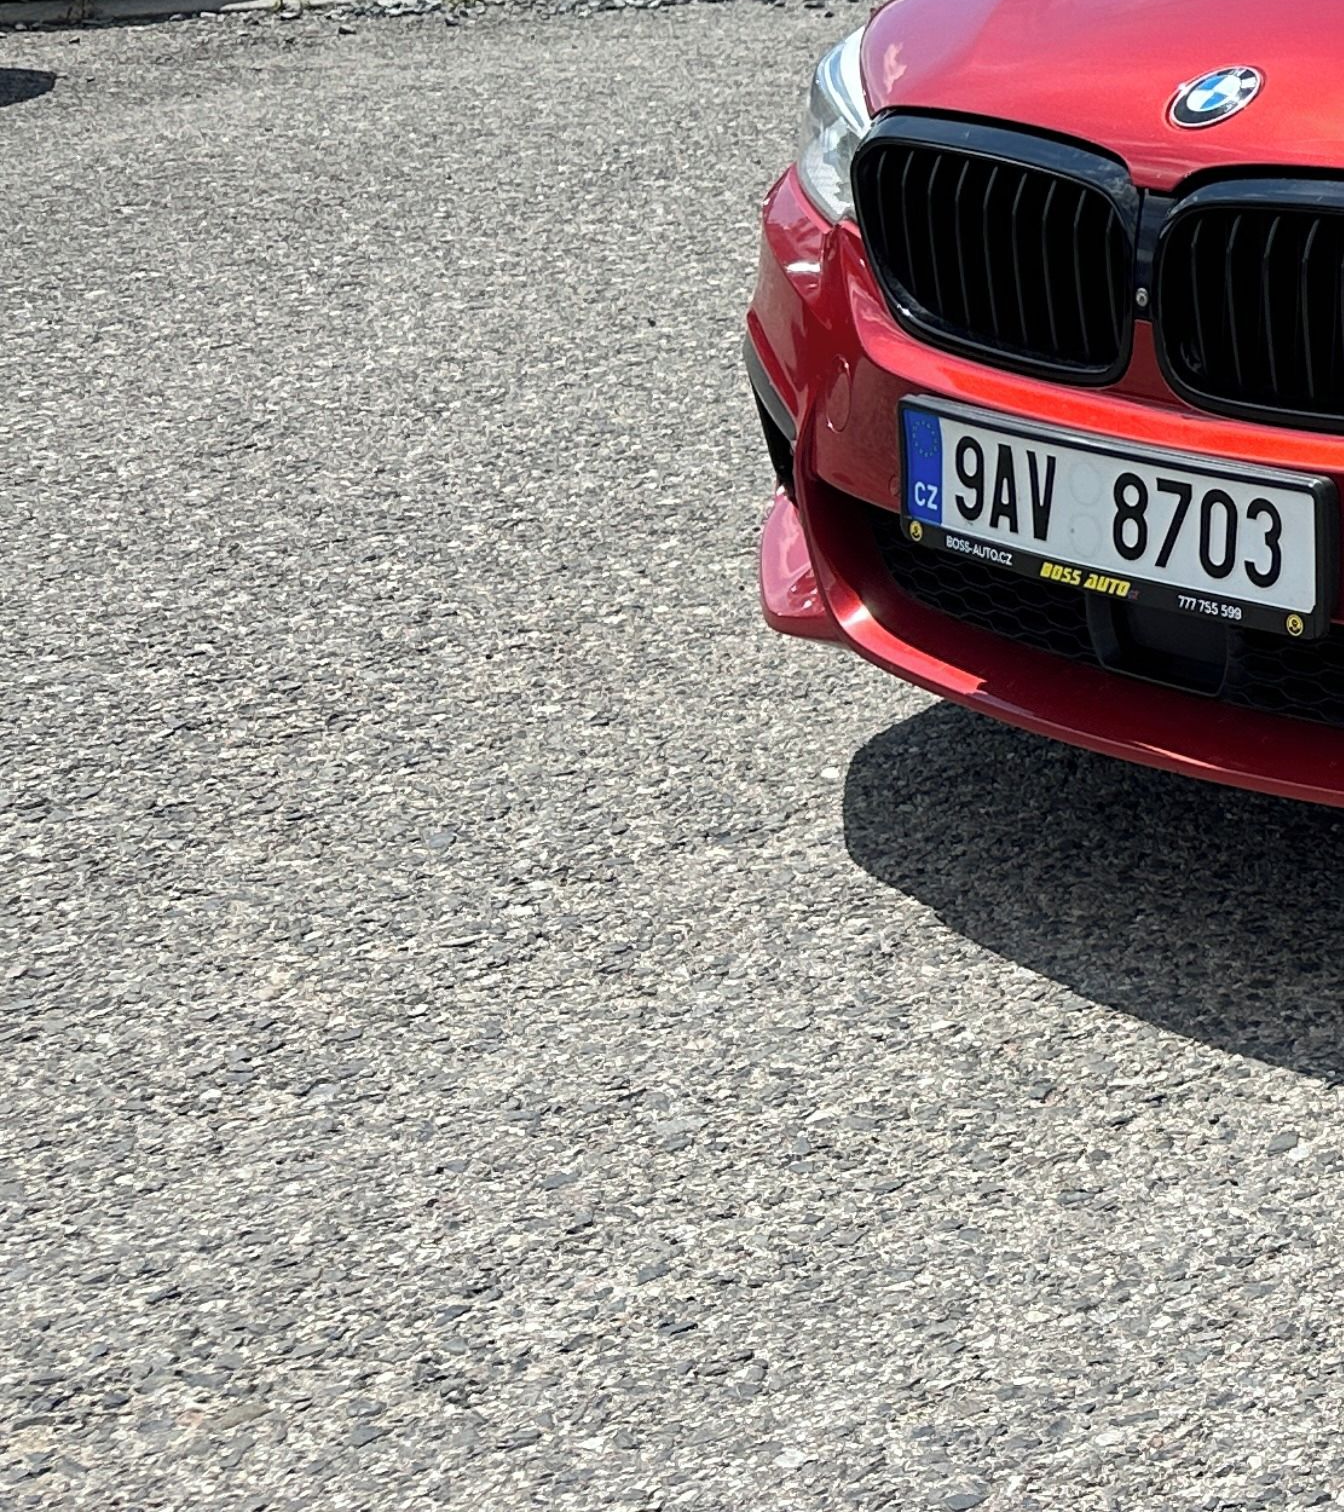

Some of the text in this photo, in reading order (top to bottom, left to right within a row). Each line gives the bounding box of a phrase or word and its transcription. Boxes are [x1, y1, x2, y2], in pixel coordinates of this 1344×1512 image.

[914, 435, 1282, 589] CZ 9AV 8703
[946, 535, 1013, 566] BOSS-AUTO.CZ
[1040, 561, 1082, 586] BOSS
[1083, 574, 1131, 597] AUTO
[1178, 594, 1197, 611] 777
[1199, 599, 1219, 616] 755
